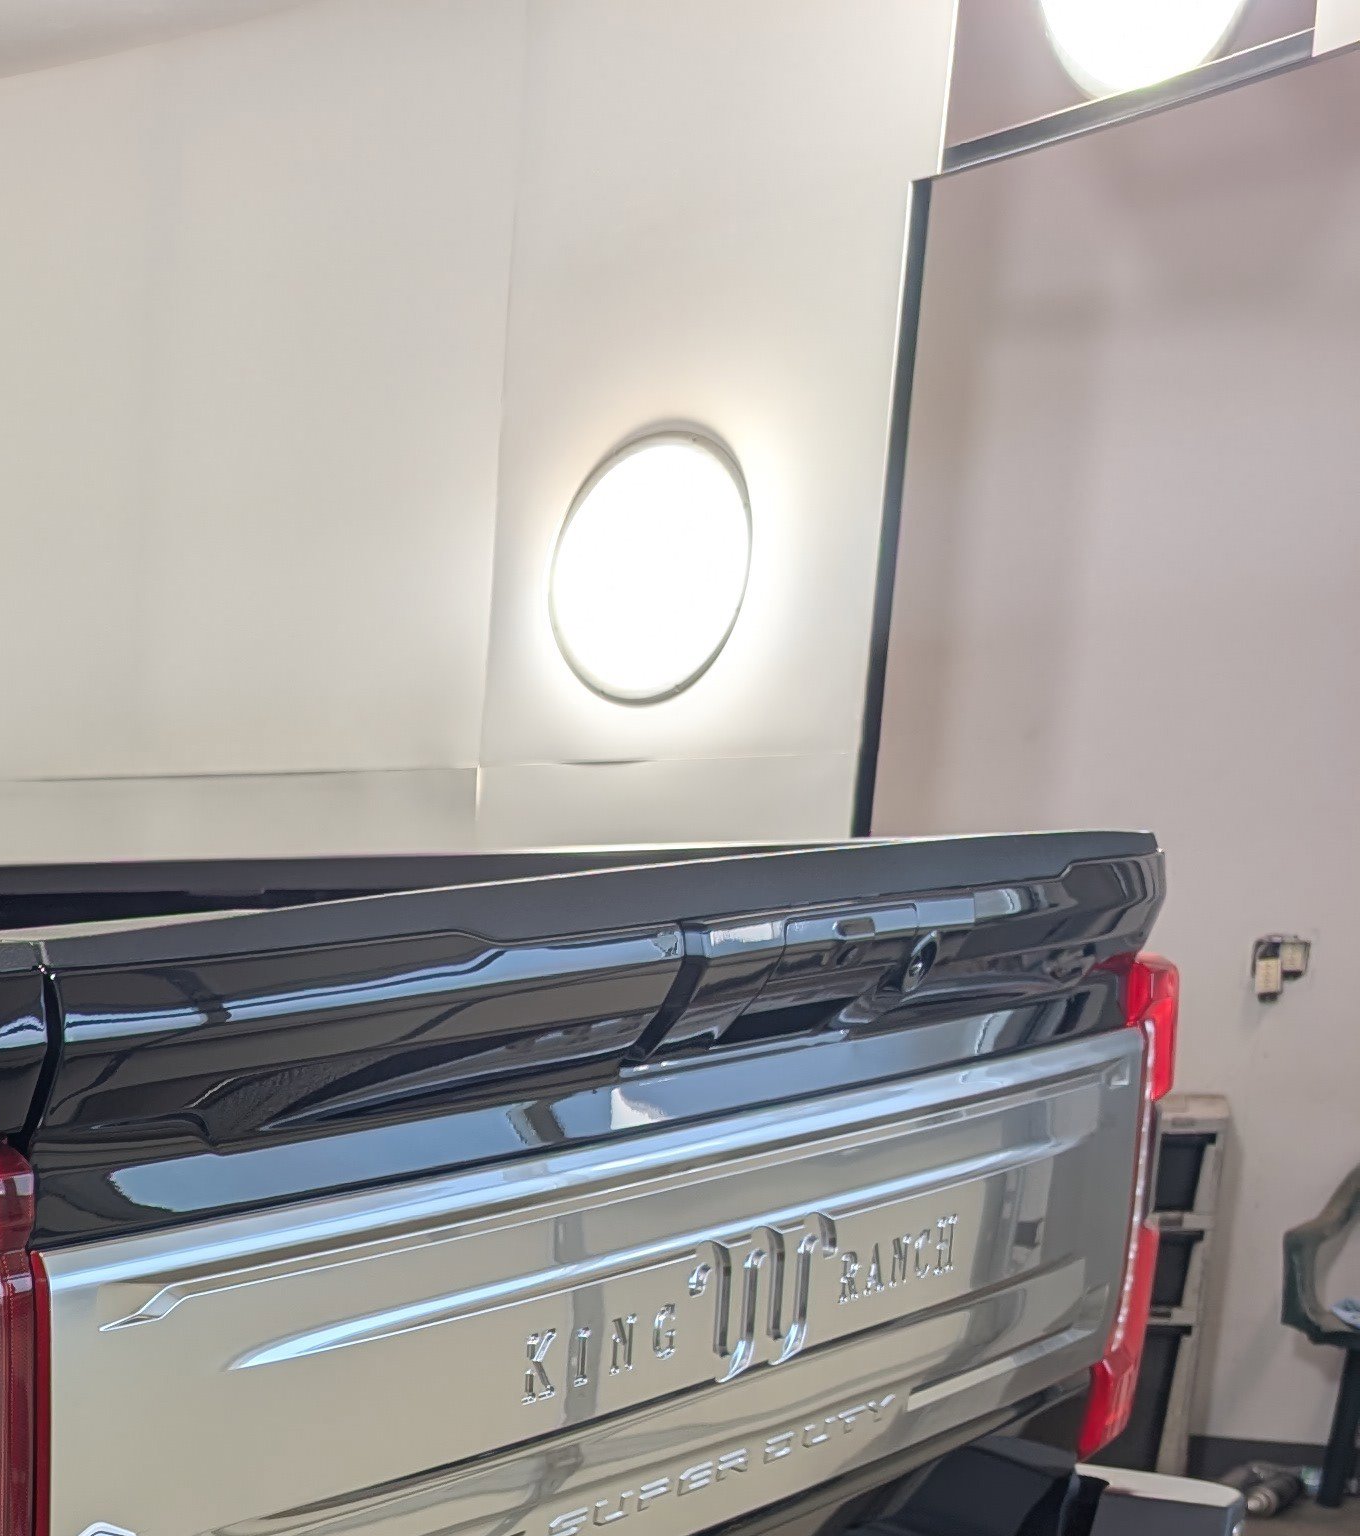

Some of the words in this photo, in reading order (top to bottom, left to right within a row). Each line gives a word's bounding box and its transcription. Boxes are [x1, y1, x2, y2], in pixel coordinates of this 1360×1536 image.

[521, 1303, 677, 1406] KING
[837, 1213, 960, 1305] RANCH
[763, 1393, 897, 1466] DUTY
